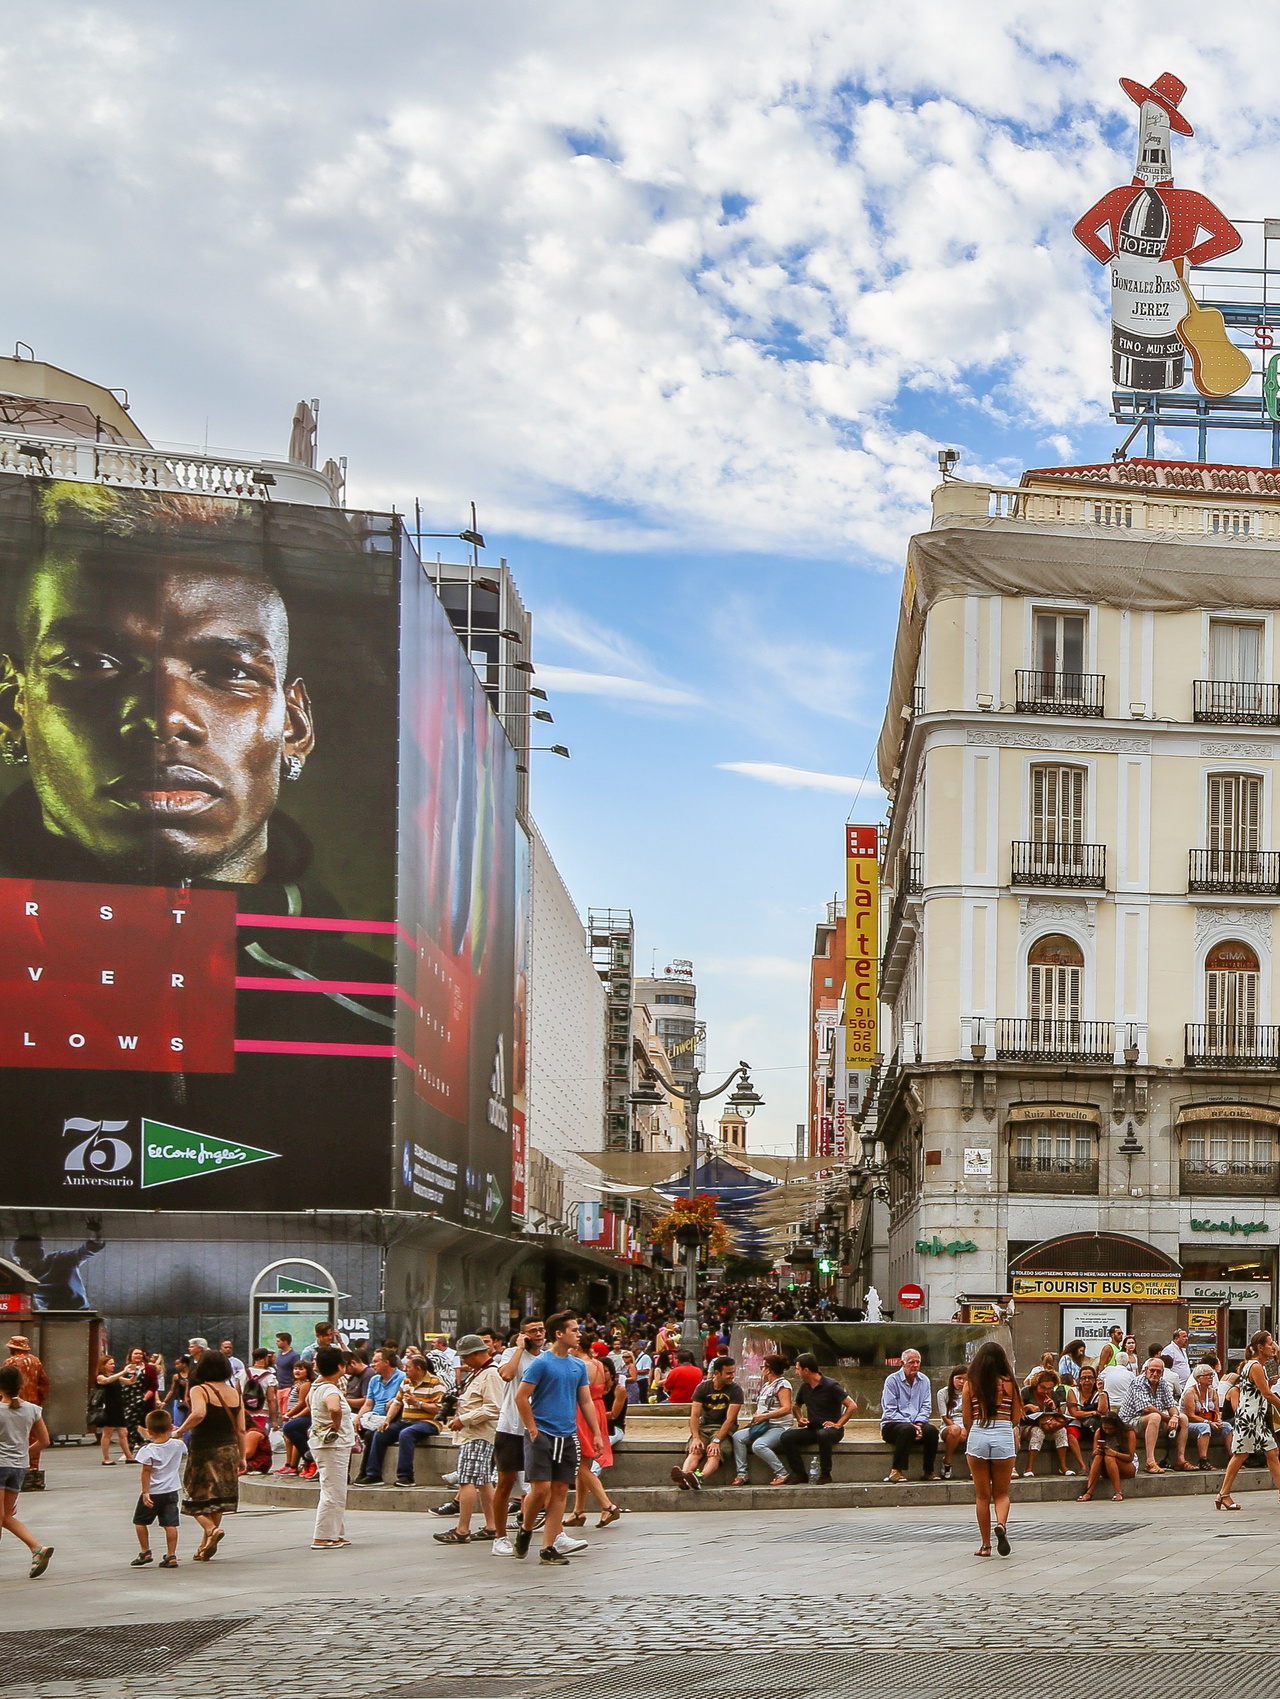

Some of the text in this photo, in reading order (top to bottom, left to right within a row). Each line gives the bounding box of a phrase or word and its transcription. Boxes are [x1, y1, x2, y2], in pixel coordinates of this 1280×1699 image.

[1120, 235, 1165, 256] TIO PEPE
[1132, 301, 1170, 317] JEREZ
[855, 863, 872, 1001] Lartec
[855, 1008, 870, 1018] 91
[848, 1019, 876, 1030] 560
[853, 1031, 871, 1041] 52
[853, 1042, 871, 1053] 06
[835, 1101, 845, 1137] Locker
[1024, 1110, 1088, 1119] Ruiz Revuelto
[62, 1117, 133, 1172] 75
[147, 1144, 163, 1159] El
[162, 1144, 197, 1159] Corte
[62, 1174, 134, 1187] Aniversario
[1035, 1281, 1132, 1294] TOURIST BUS
[1146, 1288, 1176, 1296] TICKETS
